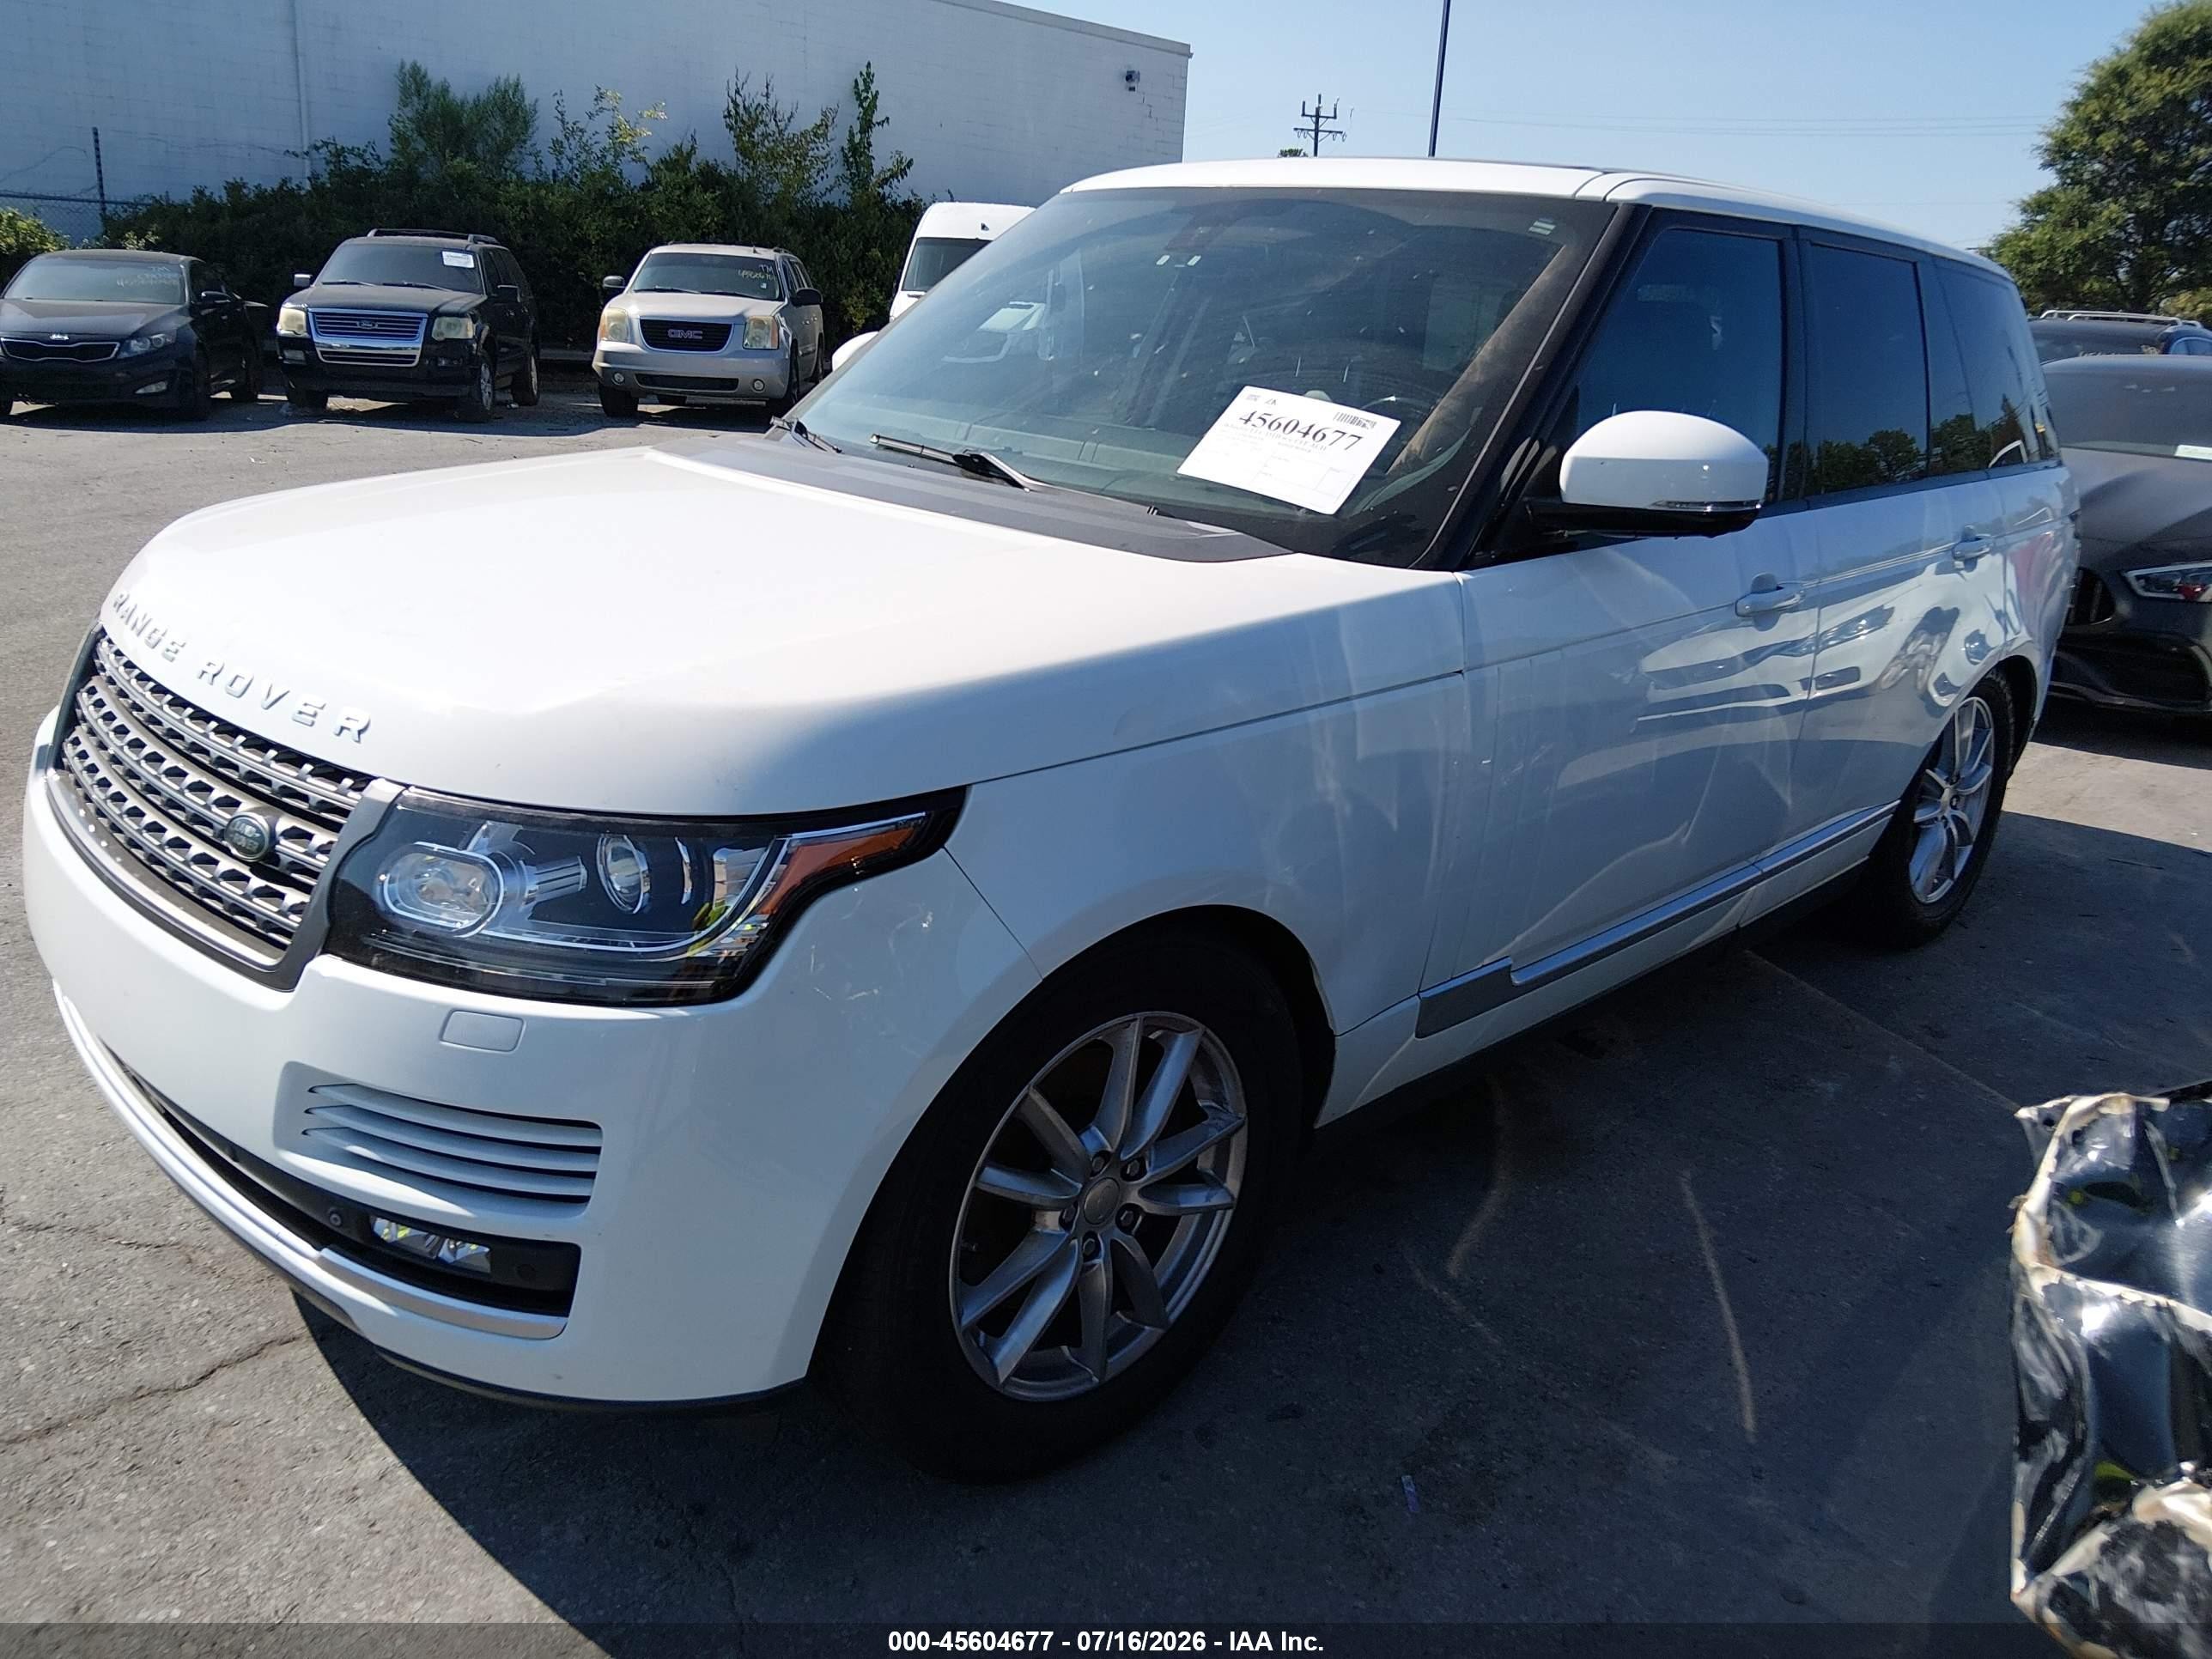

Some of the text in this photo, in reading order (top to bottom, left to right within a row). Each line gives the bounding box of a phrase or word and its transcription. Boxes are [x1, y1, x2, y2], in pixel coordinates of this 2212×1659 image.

[667, 329, 703, 340] GMC
[1239, 410, 1364, 451] 45604677
[112, 591, 372, 744] RANGE ROVER
